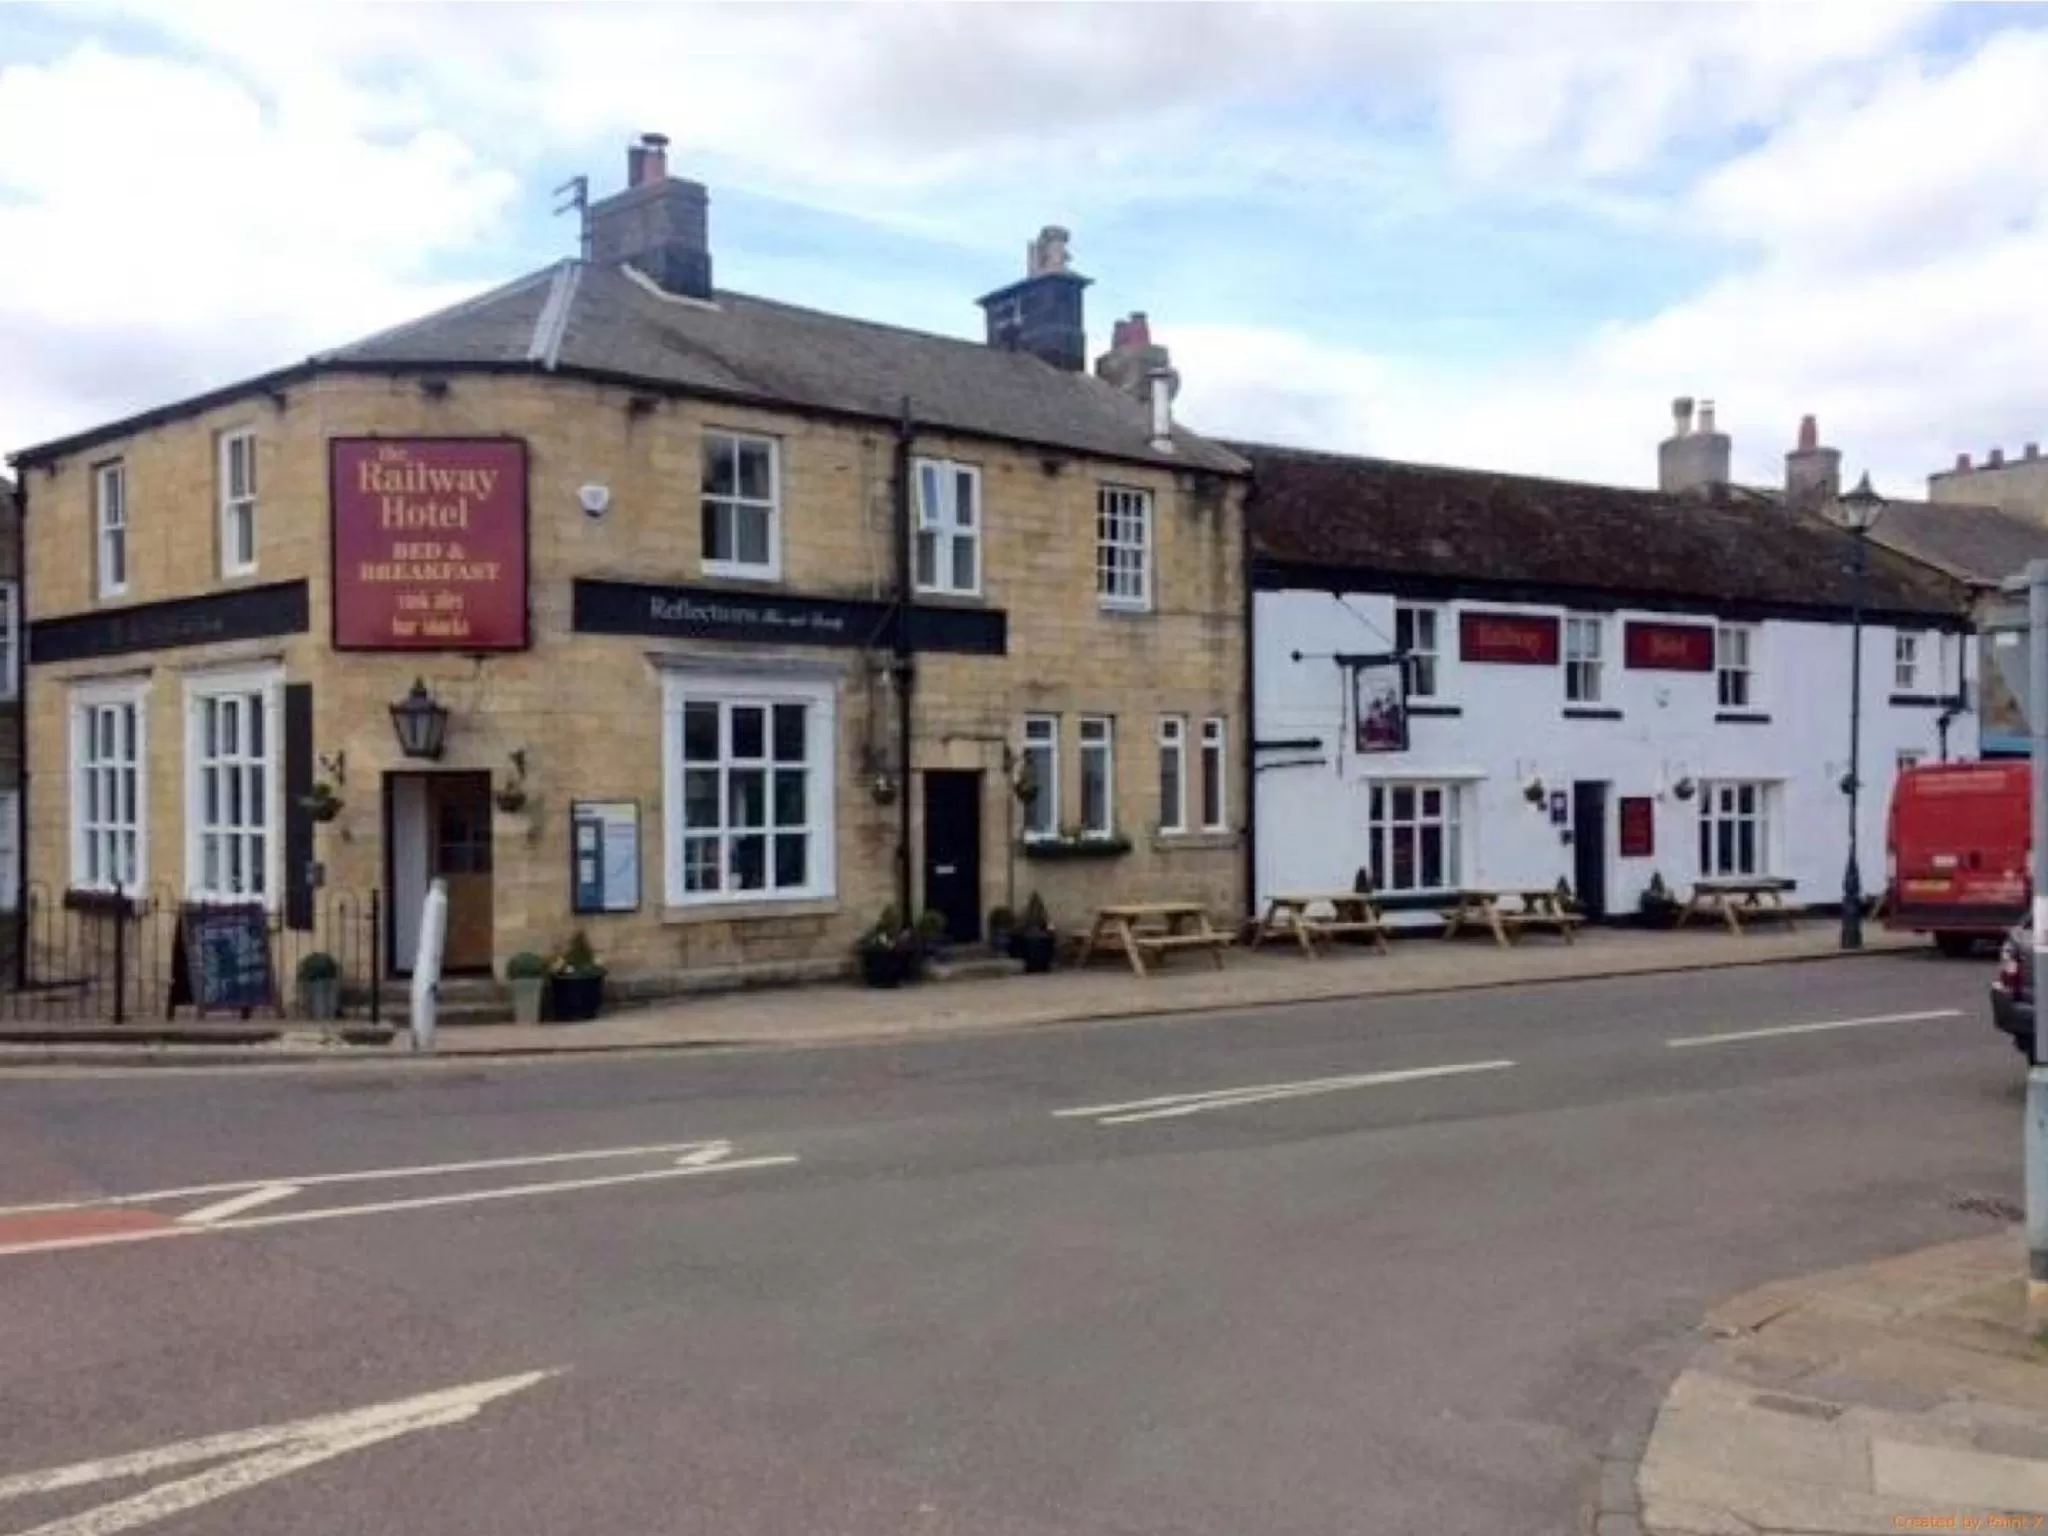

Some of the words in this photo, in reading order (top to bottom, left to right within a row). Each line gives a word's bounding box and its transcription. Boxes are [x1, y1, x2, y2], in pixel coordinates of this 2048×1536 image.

[358, 460, 499, 501] Railway
[381, 496, 469, 529] Hotel
[392, 542, 441, 560] BED
[360, 562, 500, 581] BREAKFAST
